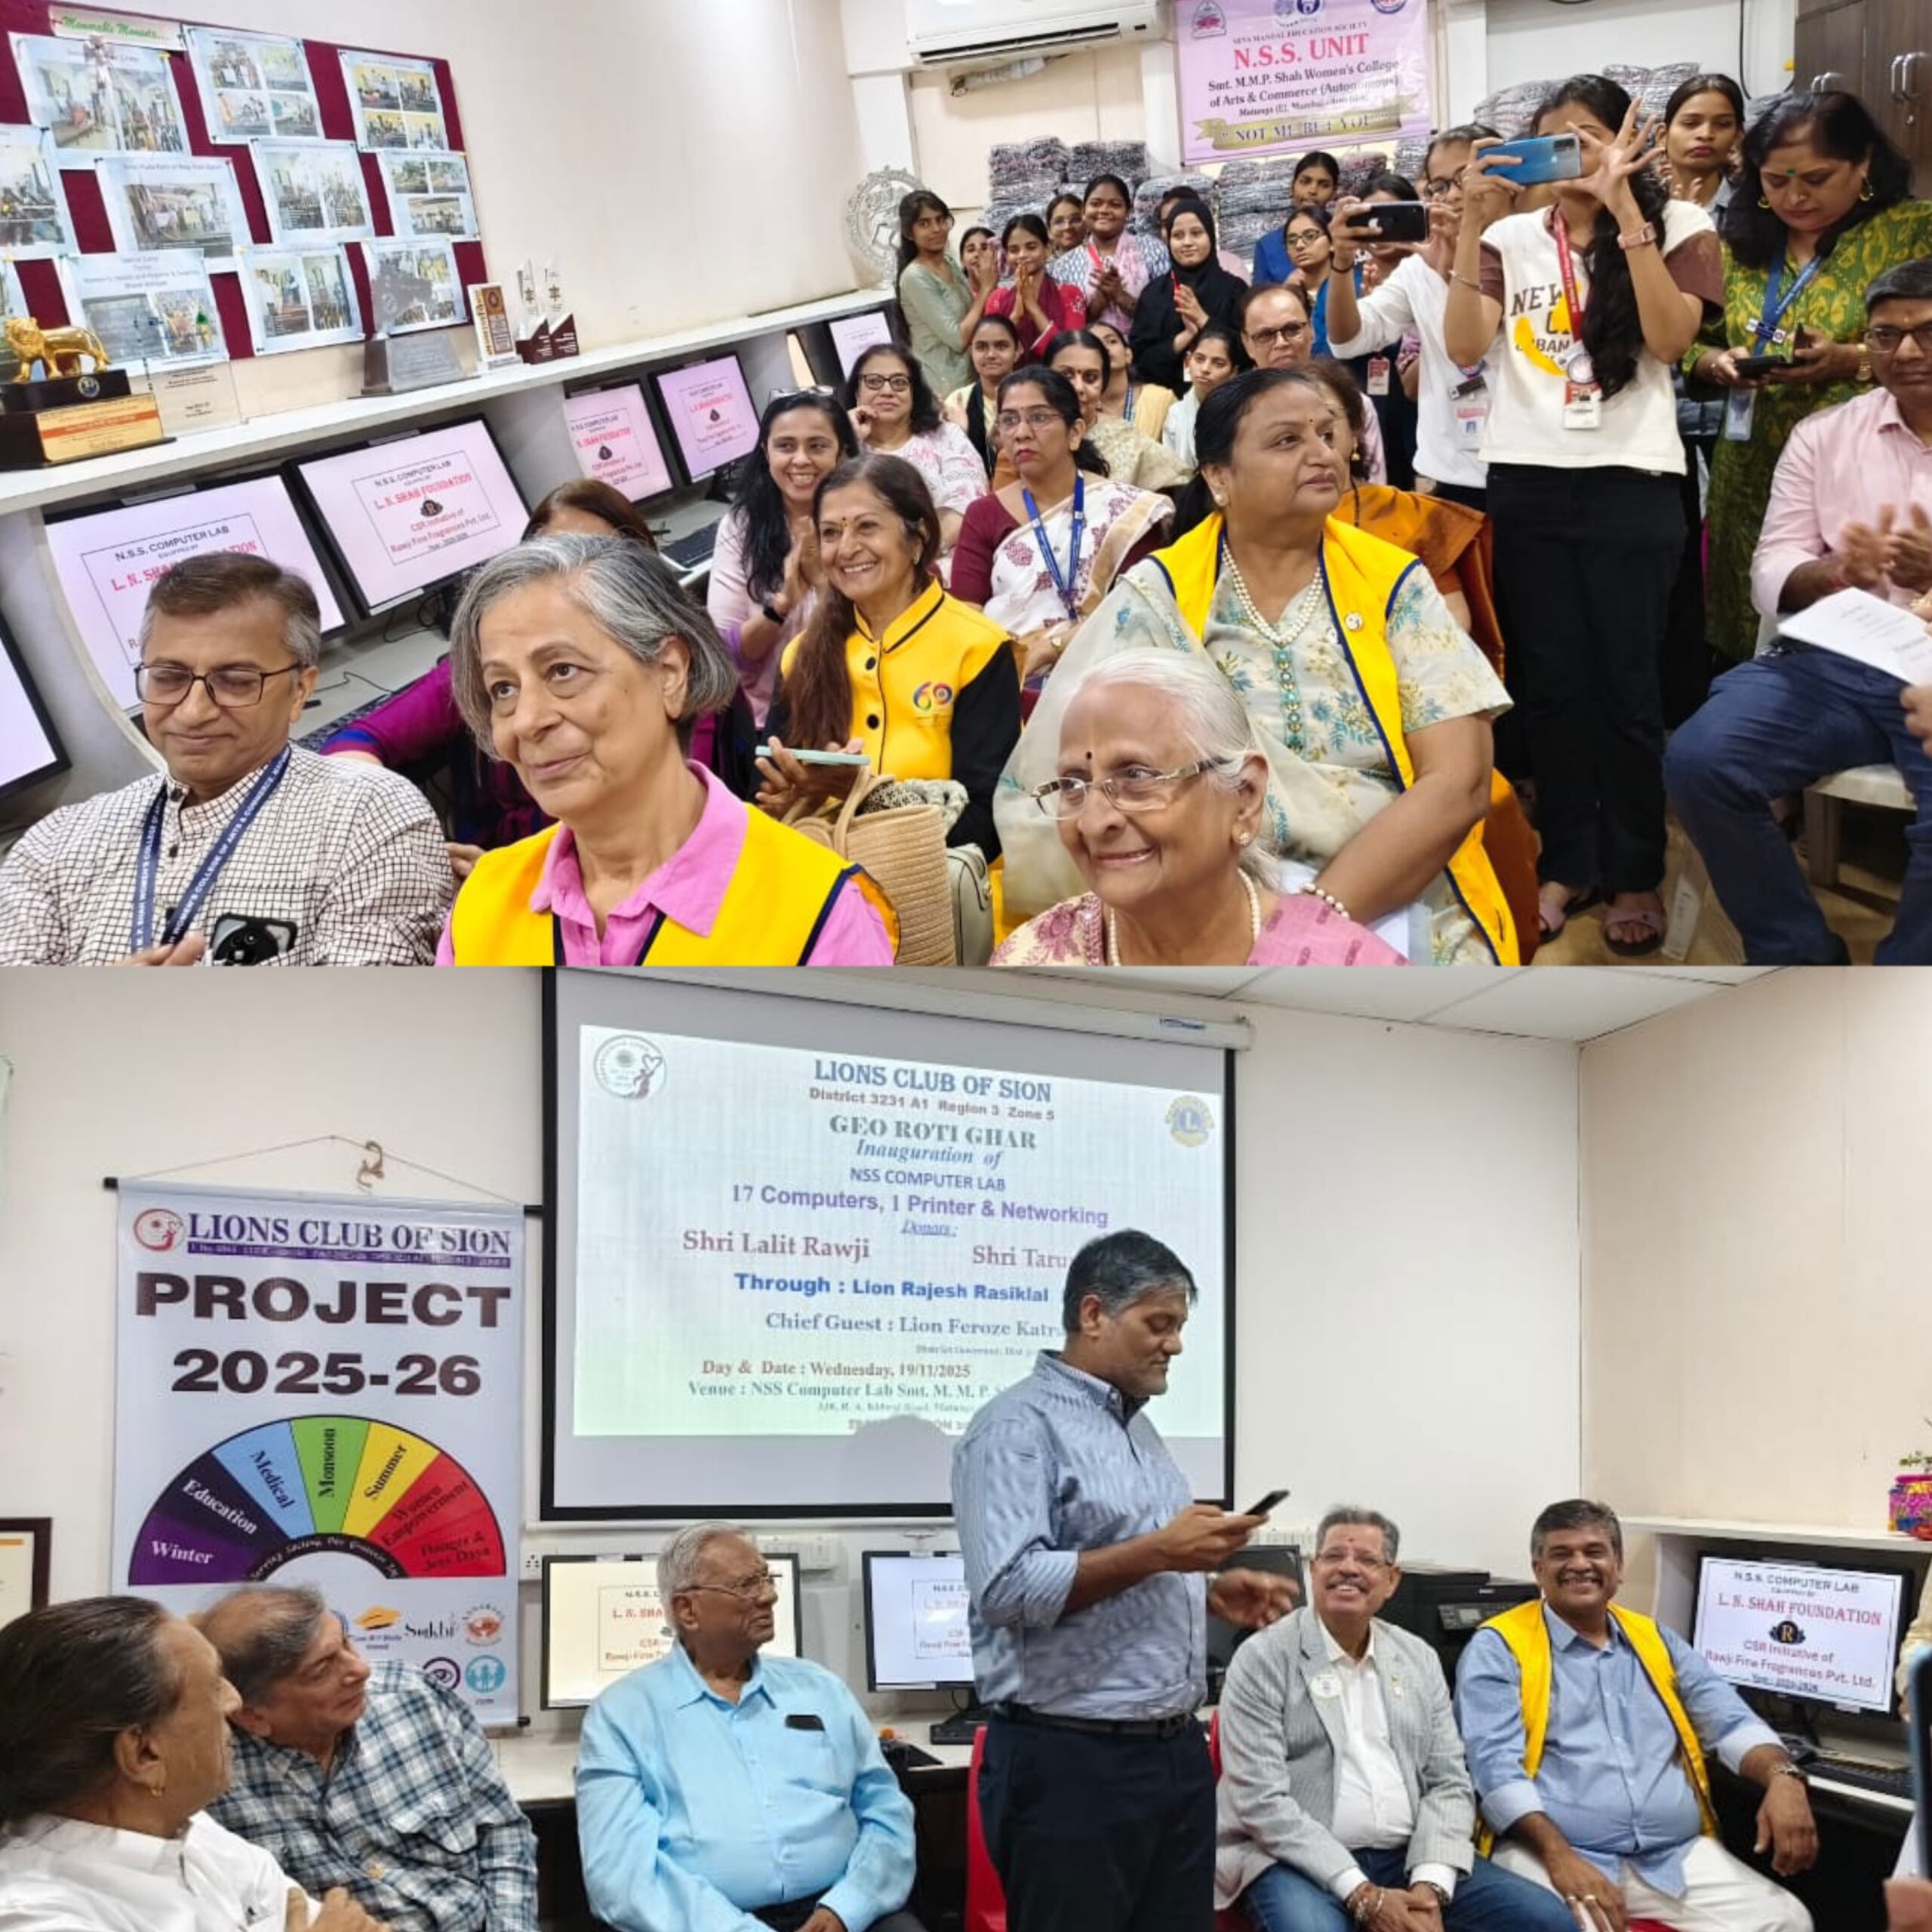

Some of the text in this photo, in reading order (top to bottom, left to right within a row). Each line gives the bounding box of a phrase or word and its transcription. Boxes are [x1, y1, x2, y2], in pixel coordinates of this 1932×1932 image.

[1287, 26, 1332, 38] EDUCATION
[1234, 32, 1369, 69] N.S.S. UNIT
[1208, 60, 1399, 91] Smt. M.M.P. Shah Women's College
[1210, 97, 1220, 107] of
[1223, 91, 1244, 105] Arts
[1247, 91, 1257, 103] &
[1259, 85, 1318, 101] Commerce
[1235, 127, 1267, 142] NOT
[115, 547, 148, 562] N.S.S.
[149, 531, 208, 552] COMPUTER
[209, 525, 229, 538] LAB
[195, 855, 223, 893] COLLEGE
[226, 823, 243, 844] ARTS
[814, 1059, 1051, 1103] LIONS CLUB OF SION
[809, 1087, 1055, 1121] District 3231 A1 Region 3 Zone 5
[829, 1115, 1037, 1149] GEO ROTI GHAR
[856, 1138, 1005, 1170] Inauguration of
[850, 1168, 1007, 1192] NSS COMPUTER LAB
[733, 1184, 754, 1202] 17
[761, 1184, 884, 1214] Computers,
[907, 1195, 976, 1217] Printer
[980, 1200, 995, 1217] &
[1000, 1201, 1109, 1228] Networking
[188, 1213, 511, 1254] LIONS CLUB OF SION
[683, 1229, 1072, 1268] Shri Lalit Rawji Shri Taru
[135, 1272, 511, 1327] PROJECT
[734, 1272, 831, 1297] Through
[852, 1279, 895, 1295] Lion
[901, 1281, 967, 1300] Rajesh
[974, 1284, 1049, 1302] Rasiklal
[765, 1312, 823, 1331] Chief
[825, 1314, 882, 1331] Guest
[900, 1316, 943, 1333] Lion
[949, 1319, 1011, 1335] Feroze
[171, 1349, 481, 1395] 2025-26
[703, 1361, 732, 1377] Day
[738, 1361, 752, 1374] &
[761, 1361, 797, 1374] Date
[811, 1361, 895, 1380] Wednesday,
[899, 1363, 971, 1377] 19/11/2025
[688, 1381, 737, 1396] Venue
[752, 1381, 783, 1395] NSS
[787, 1382, 861, 1399] Computer
[866, 1383, 893, 1395] Lab
[250, 1450, 296, 1509] Medical
[318, 1429, 335, 1497] Monsoon
[364, 1444, 407, 1500] Summer
[183, 1479, 258, 1535] Education
[151, 1540, 214, 1564] Winter
[1767, 1574, 1831, 1590] COMPUTER
[1834, 1579, 1860, 1593] LAB
[1747, 1597, 1786, 1614] SHAH
[1789, 1601, 1882, 1626] FOUNDATION
[1743, 1640, 1835, 1663] CSR Initiative of
